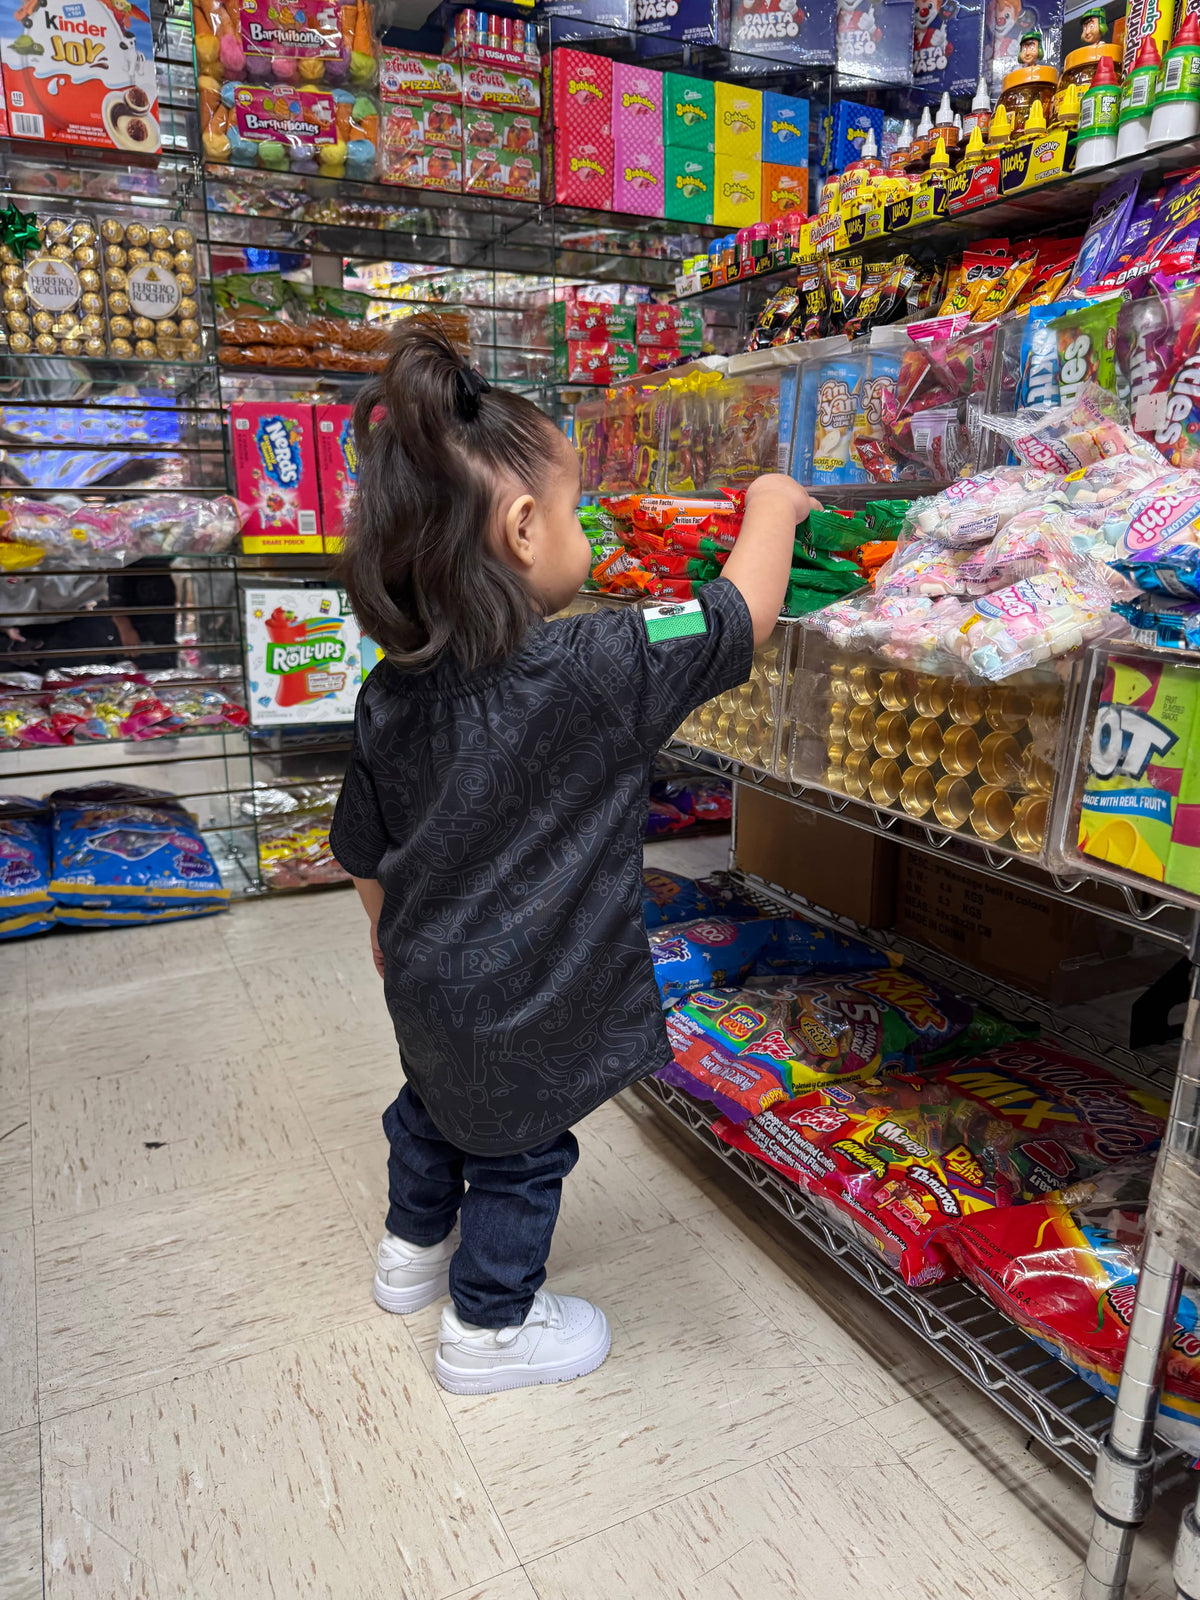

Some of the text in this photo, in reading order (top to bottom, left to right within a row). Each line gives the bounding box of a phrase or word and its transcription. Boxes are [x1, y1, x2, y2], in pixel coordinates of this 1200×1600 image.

[637, 1, 679, 22] YASO
[744, 12, 794, 25] PALETA
[1142, 0, 1161, 36] Sque
[44, 11, 107, 38] Kinder
[249, 22, 325, 46] Barquibones
[739, 22, 799, 39] PAYASO
[840, 31, 871, 42] LETA
[50, 35, 105, 66] JOY
[914, 47, 943, 60] LETA
[385, 54, 424, 75] efrutti
[913, 55, 949, 73] YASO
[401, 79, 442, 91] PIZZA
[469, 68, 505, 88] efrutti
[484, 92, 521, 104] PIZZA
[568, 80, 603, 100] Bubbaloo
[622, 93, 656, 112] Bubbaloo
[675, 103, 707, 120] Bubbaloo
[245, 113, 320, 135] Barquibones
[771, 120, 801, 137] Bubbaloo
[425, 132, 446, 142] PIZZA
[1033, 141, 1060, 157] GUSANO
[570, 158, 605, 176] Bubbaloo
[1002, 151, 1028, 178] LUCAS
[424, 177, 445, 187] PIZZA
[468, 179, 489, 189] IZZA
[625, 168, 657, 185] Bubbaloo
[675, 175, 707, 192] Bubbaloo
[947, 172, 968, 194] LUCAS
[505, 186, 524, 195] PIZZA
[892, 200, 910, 222] LUCAS
[810, 214, 842, 245] Pulparindo
[30, 276, 74, 287] FERRERO
[32, 285, 75, 296] ROCHER
[131, 282, 175, 294] FERRERO
[132, 291, 175, 304] ROCHER
[265, 420, 298, 483] Nerds
[273, 642, 343, 672] ROLL-UPS
[1100, 795, 1118, 807] WITH
[1119, 795, 1139, 808] REAL
[905, 908, 927, 928] MADE
[928, 919, 938, 930] IN
[939, 925, 966, 943] CHINA
[841, 1002, 880, 1025] 5
[803, 1022, 832, 1054] FRUIT
[851, 1024, 865, 1057] LIBRAS
[862, 1023, 877, 1062] POUNDS
[700, 1054, 716, 1070] Net
[945, 1071, 1081, 1129] MIX
[762, 1120, 779, 1136] Chili
[774, 1131, 790, 1146] and
[786, 1142, 810, 1163] Assorted
[780, 1123, 795, 1138] and
[815, 1151, 838, 1172] Candies
[878, 1121, 930, 1158] Mango
[766, 1139, 797, 1166] Caramelos
[945, 1145, 984, 1179] Pika
[944, 1158, 982, 1186] Slice
